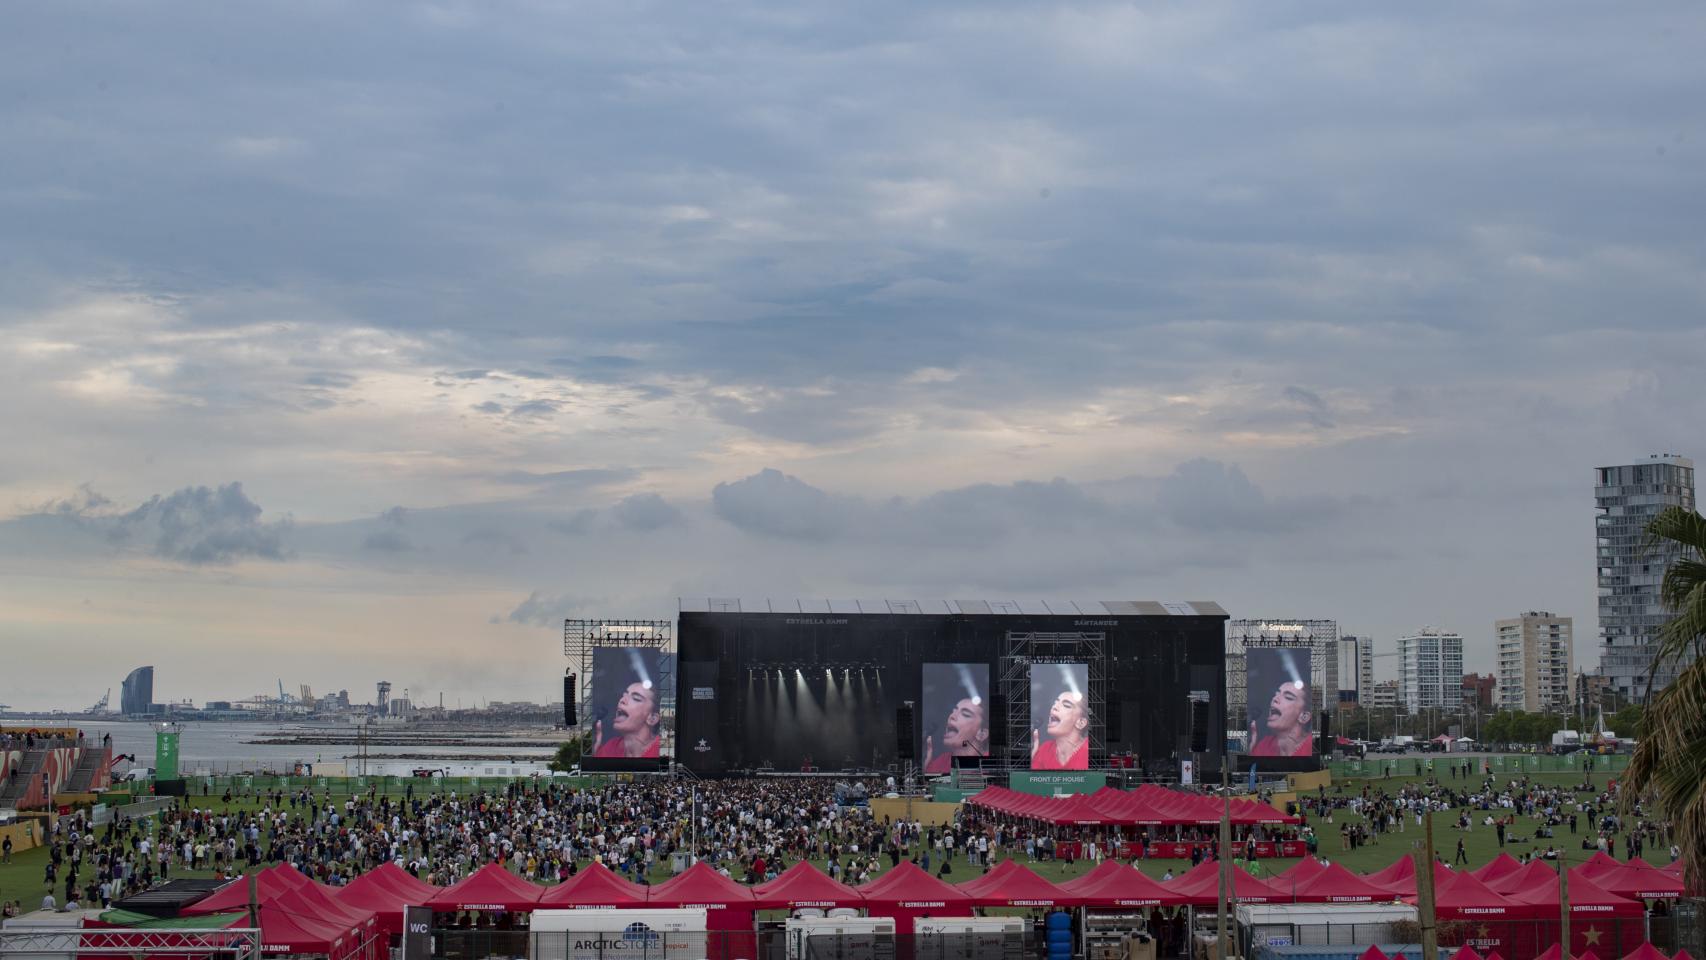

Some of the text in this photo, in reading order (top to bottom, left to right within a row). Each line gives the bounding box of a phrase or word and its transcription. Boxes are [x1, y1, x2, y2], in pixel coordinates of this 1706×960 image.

[1268, 623, 1304, 631] Santander
[410, 923, 428, 933] WC
[1466, 938, 1500, 946] ESTRELLA
